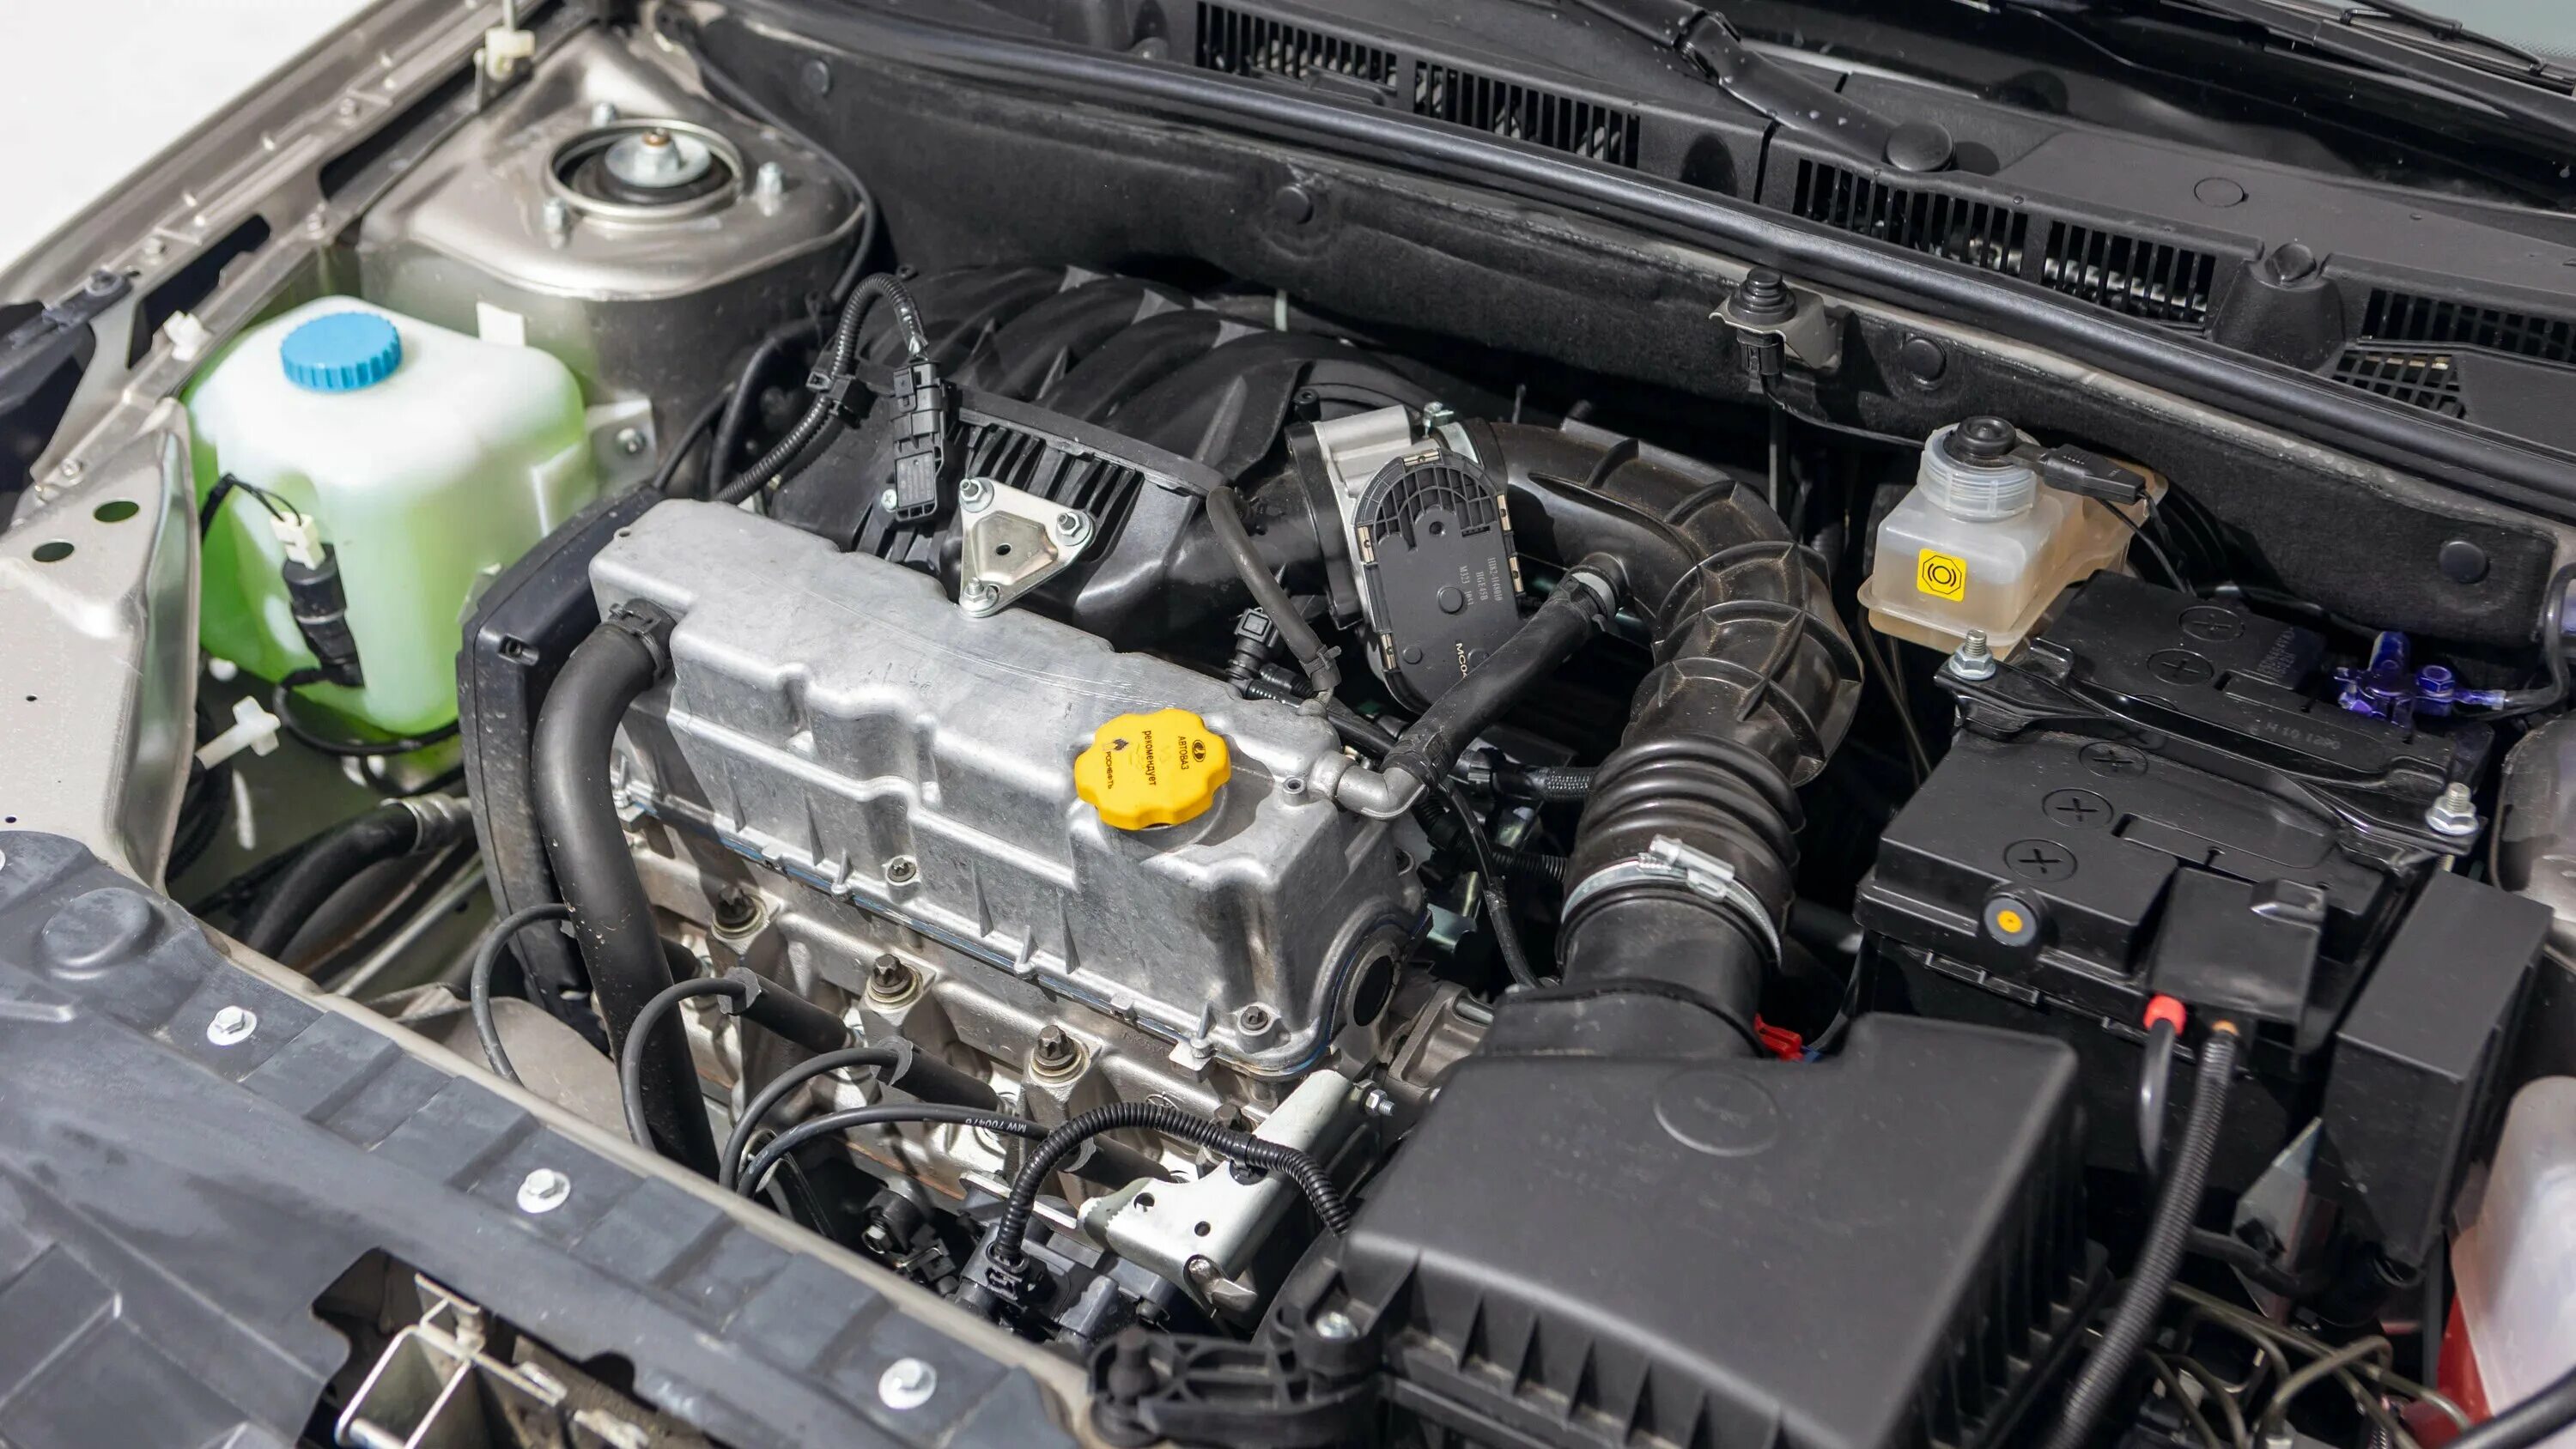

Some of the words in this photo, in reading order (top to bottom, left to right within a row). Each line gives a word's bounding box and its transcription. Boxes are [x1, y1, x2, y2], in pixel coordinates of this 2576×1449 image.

[1105, 751, 1114, 789] РОСНЕФТЬ
[1142, 730, 1157, 786] рекомендует
[1178, 736, 1189, 770] АВТОВАЗ
[1006, 1122, 1027, 1133] MW
